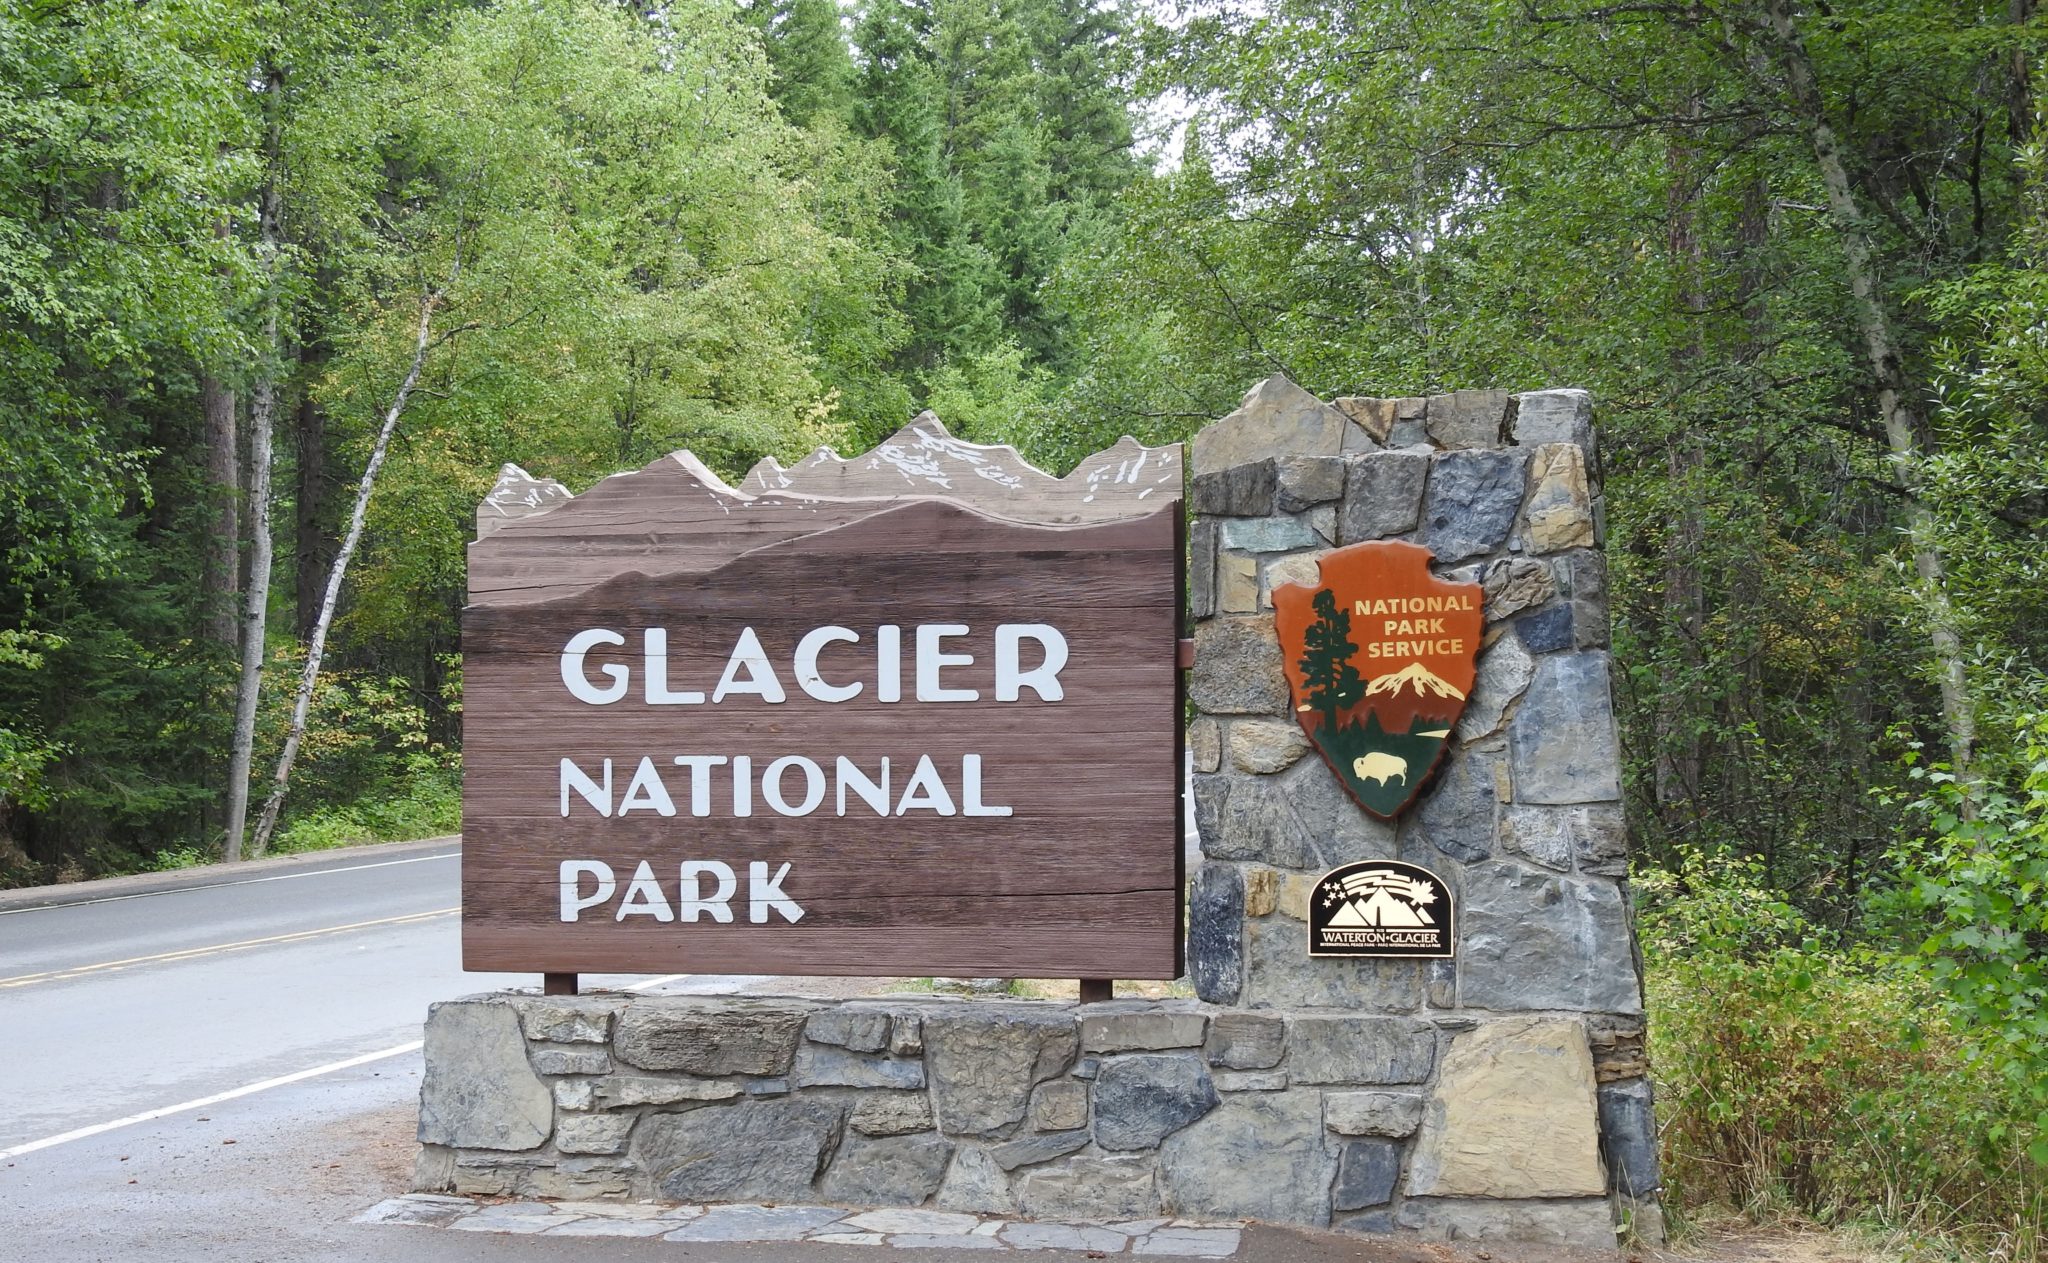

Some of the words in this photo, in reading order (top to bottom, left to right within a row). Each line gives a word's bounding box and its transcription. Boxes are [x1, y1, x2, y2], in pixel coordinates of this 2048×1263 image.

[1355, 595, 1474, 616] NATIONAL
[1384, 618, 1446, 636] PARK
[560, 623, 1069, 705] GLACIER
[1368, 639, 1464, 658] SERVICE
[560, 753, 1013, 818] NATIONAL
[559, 859, 805, 924] PARK
